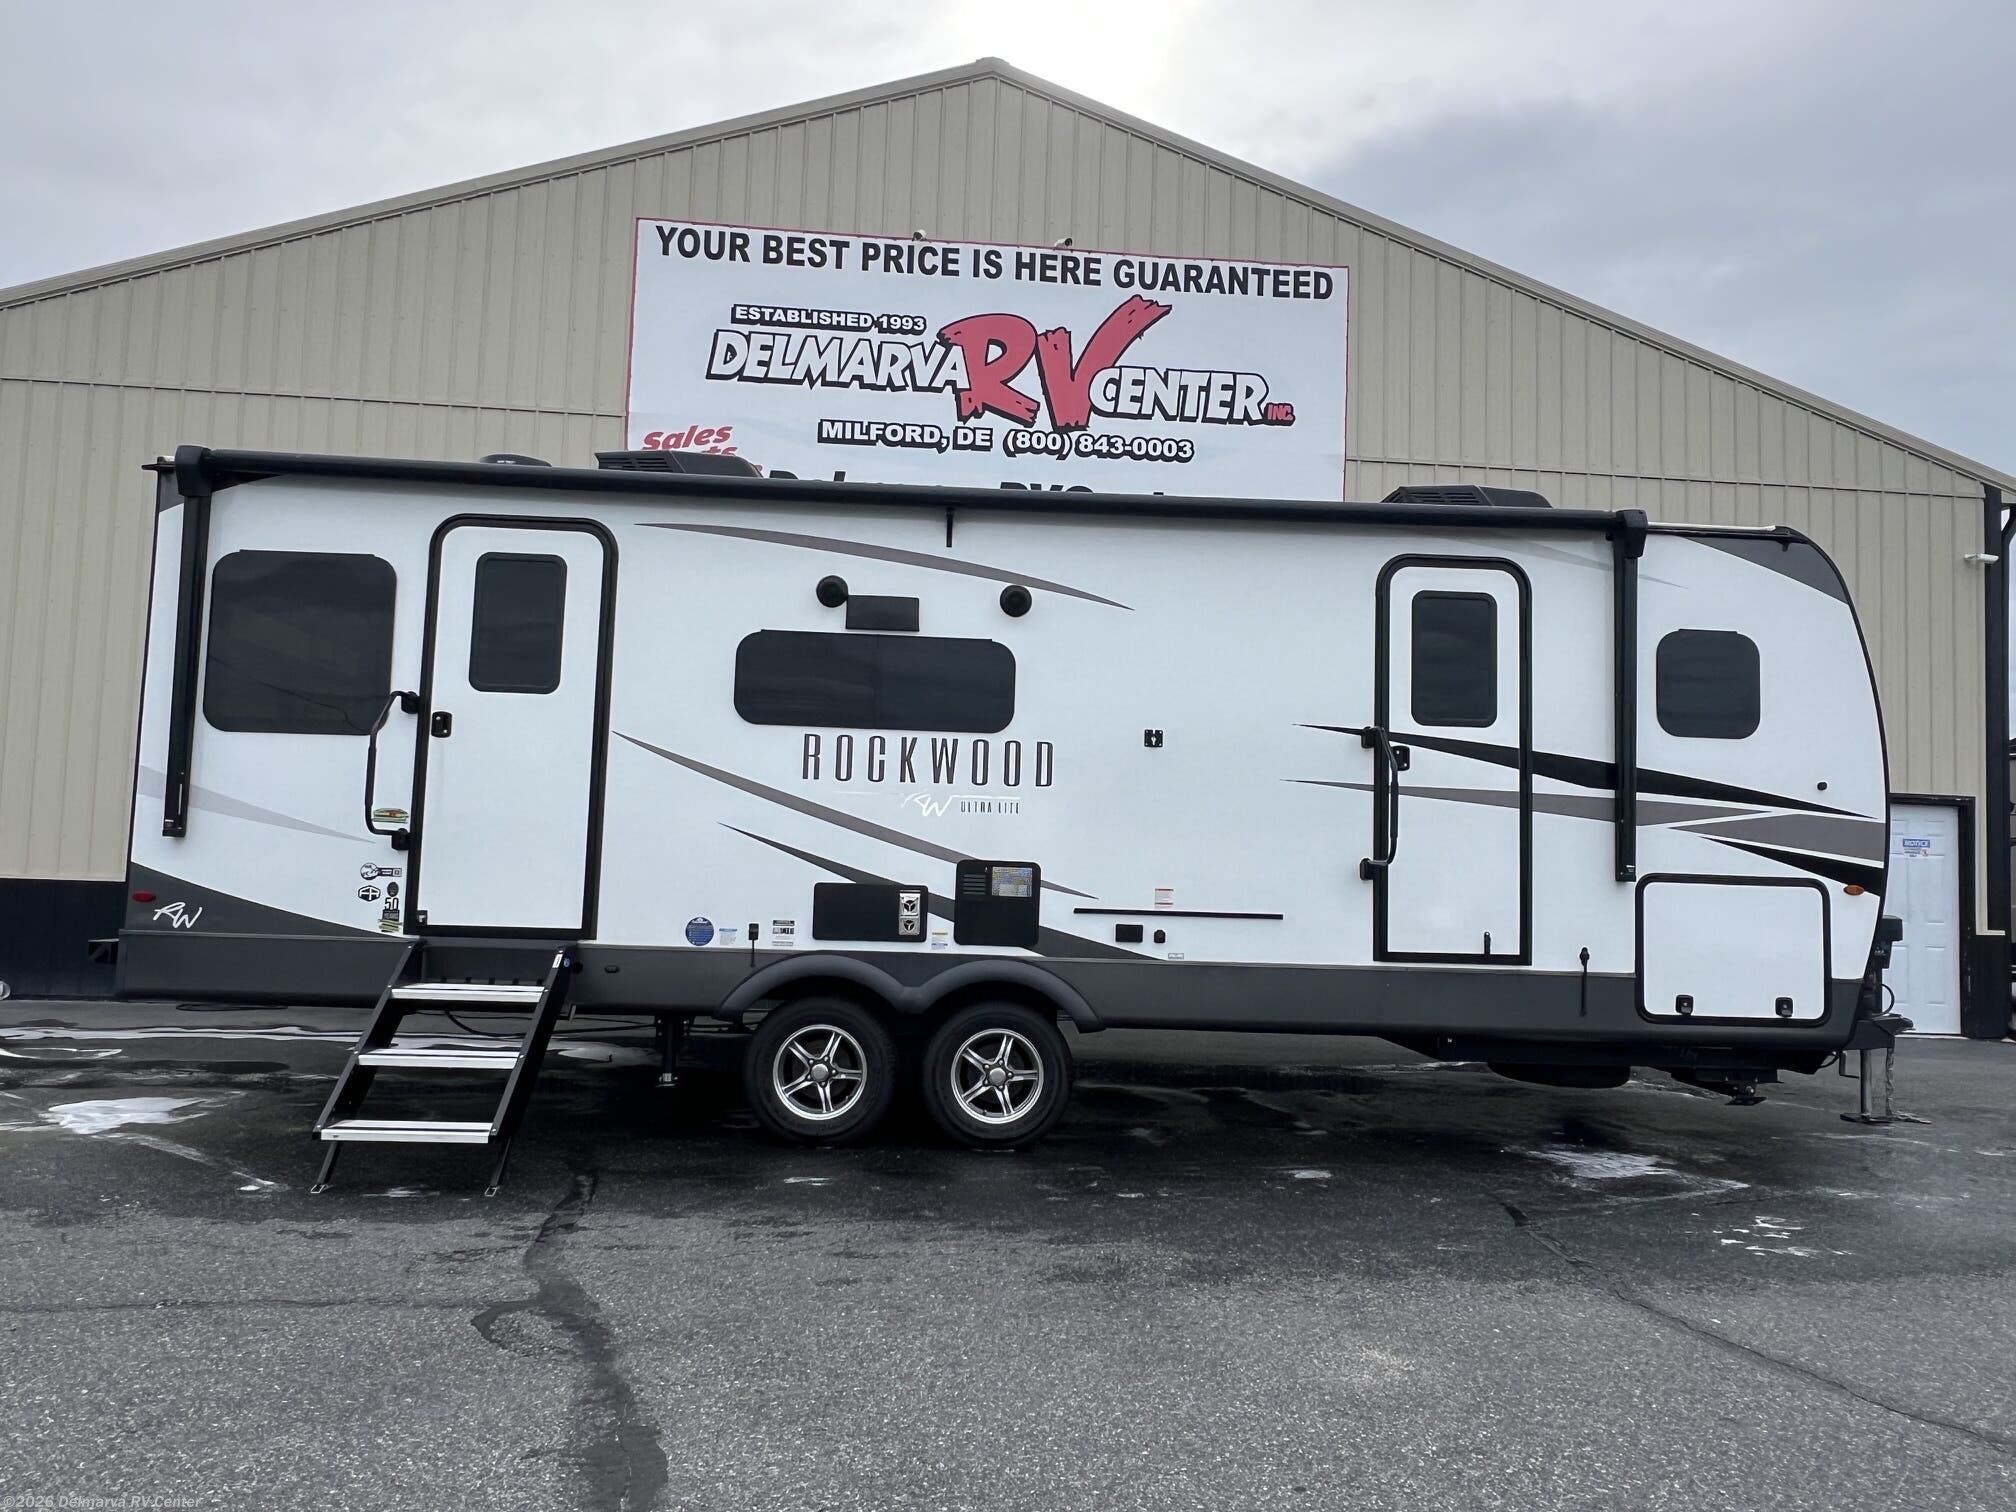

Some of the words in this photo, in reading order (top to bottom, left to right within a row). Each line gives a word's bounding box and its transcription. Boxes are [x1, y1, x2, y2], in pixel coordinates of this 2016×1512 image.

[655, 225, 751, 263] YOUR
[762, 234, 851, 270] BEST
[861, 242, 960, 277] PRICE
[972, 248, 1003, 280] IS
[1014, 251, 1102, 287] HERE
[1113, 259, 1334, 300] GUARANTEED
[732, 304, 874, 331] ESTABLISHED
[876, 314, 926, 334] 1993
[706, 328, 972, 393] DELMARVA
[936, 293, 1174, 432] RV
[1087, 365, 1270, 425] CENTER
[818, 419, 950, 453] MILFORD,
[953, 426, 993, 451] DE
[1003, 429, 1072, 460] (800)
[1074, 434, 1195, 462] 843-0003
[802, 733, 1055, 787] ROCKWOOD
[960, 801, 992, 813] ULTRA
[998, 802, 1020, 814] LITE
[384, 897, 399, 910] 50
